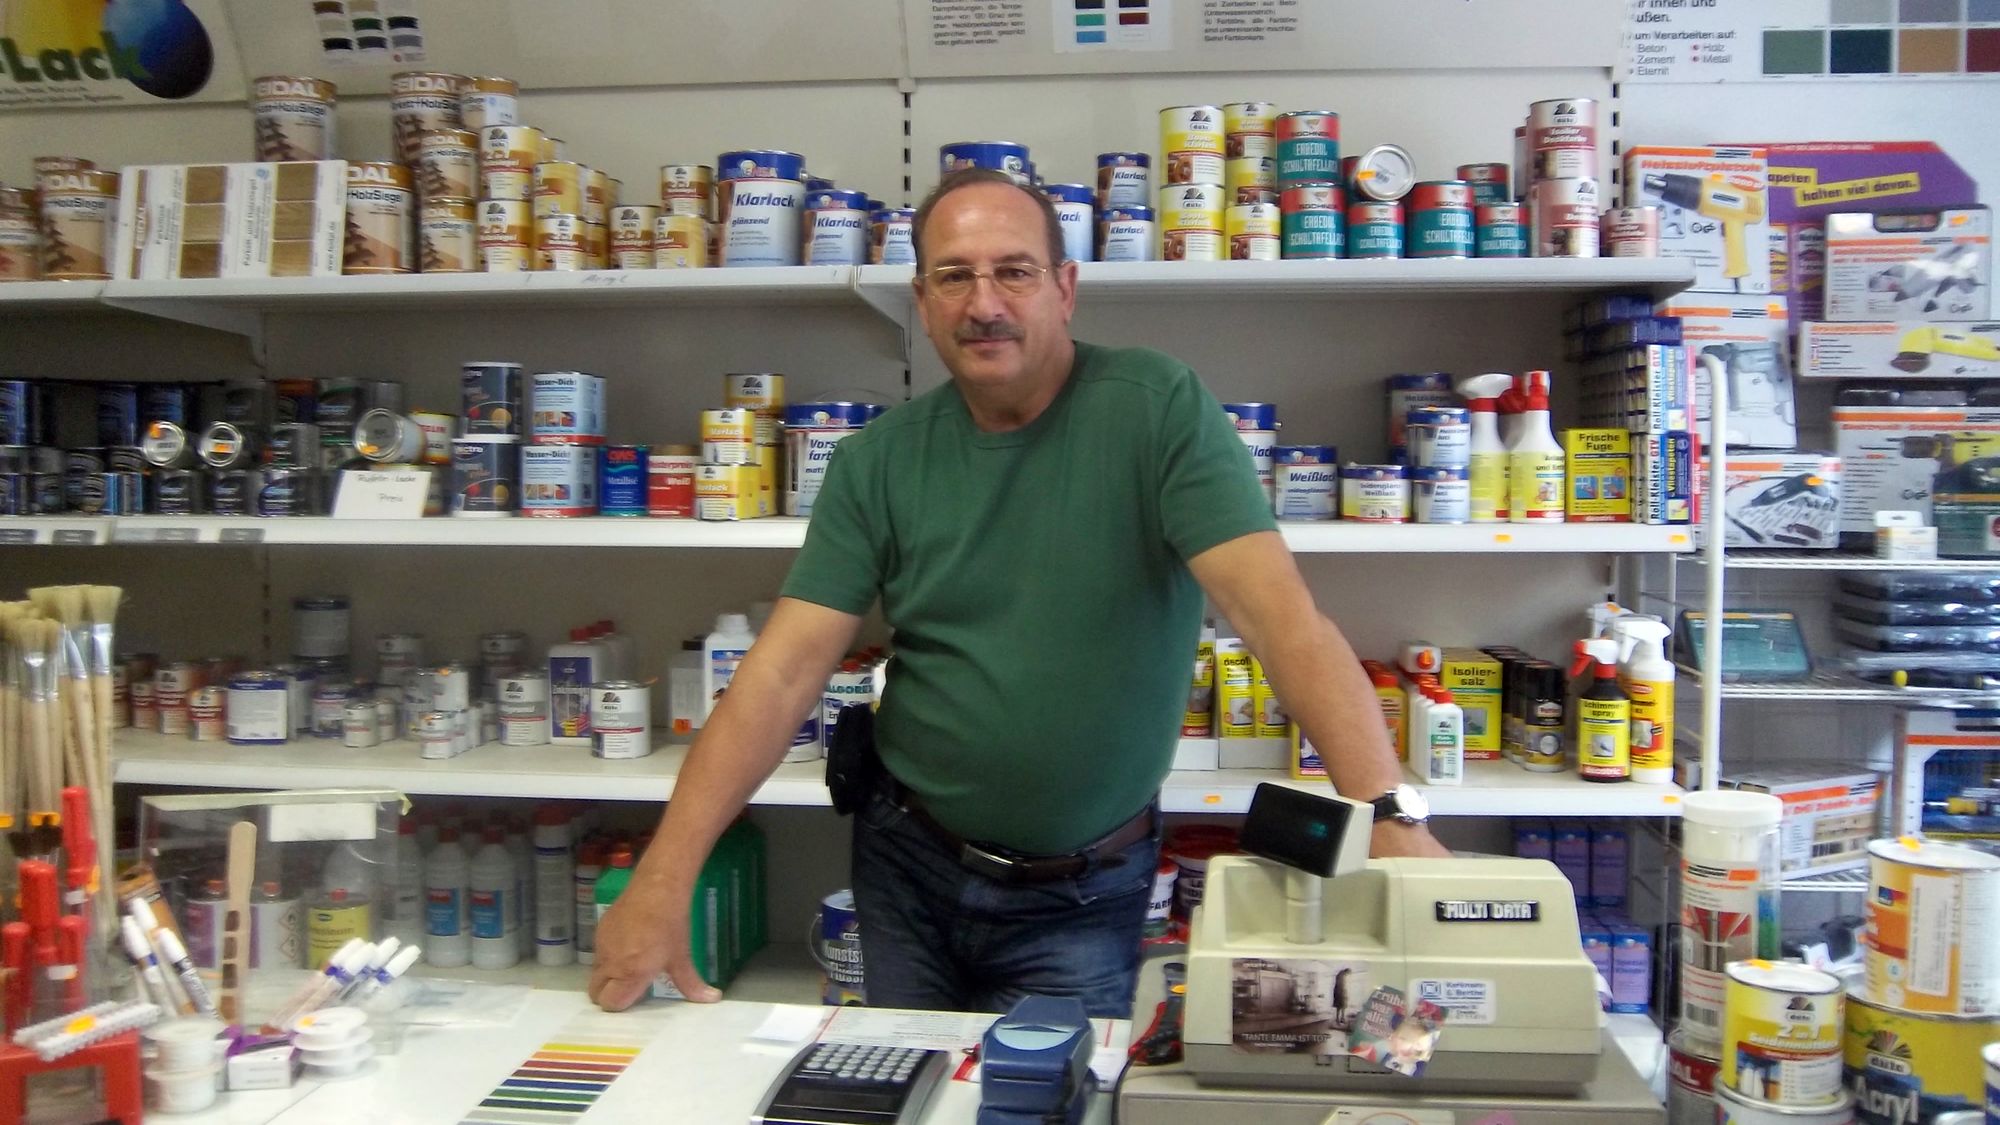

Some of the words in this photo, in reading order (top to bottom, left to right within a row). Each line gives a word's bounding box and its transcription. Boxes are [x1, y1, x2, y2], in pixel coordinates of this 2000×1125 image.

[1637, 11, 1672, 22] ußen.
[1114, 171, 1147, 181] Klarlack
[1768, 173, 1811, 184] apeten
[1803, 189, 1842, 201] halten
[1847, 184, 1869, 195] viel
[735, 193, 796, 208] Klarlack
[732, 217, 770, 227] glänzend
[817, 217, 863, 229] Klarlack
[889, 228, 912, 237] Klarl
[1110, 226, 1146, 235] Klarlack
[1578, 433, 1621, 442] Frische
[810, 438, 836, 449] Vors
[1586, 442, 1614, 452] Fuge
[1650, 439, 1660, 457] GTV
[808, 451, 832, 461] farb
[1650, 459, 1660, 520] Roll-Kleister
[1453, 667, 1497, 676] Isolier-
[1461, 677, 1485, 686] salz
[1592, 709, 1615, 718] spray
[1446, 903, 1488, 919] MULTI
[1493, 903, 1532, 919] DATA
